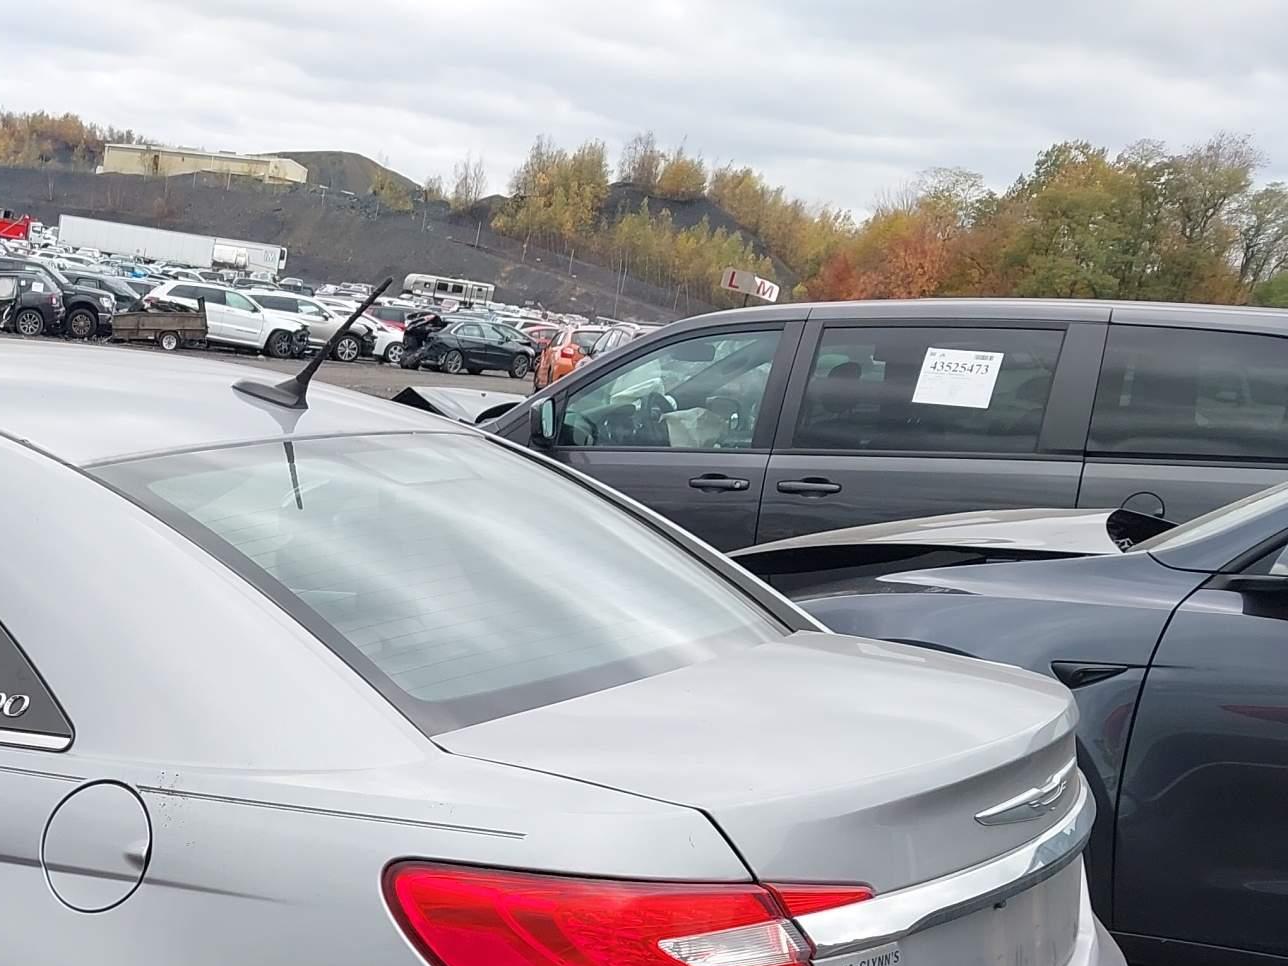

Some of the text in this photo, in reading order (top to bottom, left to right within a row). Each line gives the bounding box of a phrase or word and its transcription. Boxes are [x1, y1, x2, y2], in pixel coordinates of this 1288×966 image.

[728, 271, 739, 289] L
[756, 280, 775, 299] M
[929, 360, 990, 375] 43525473
